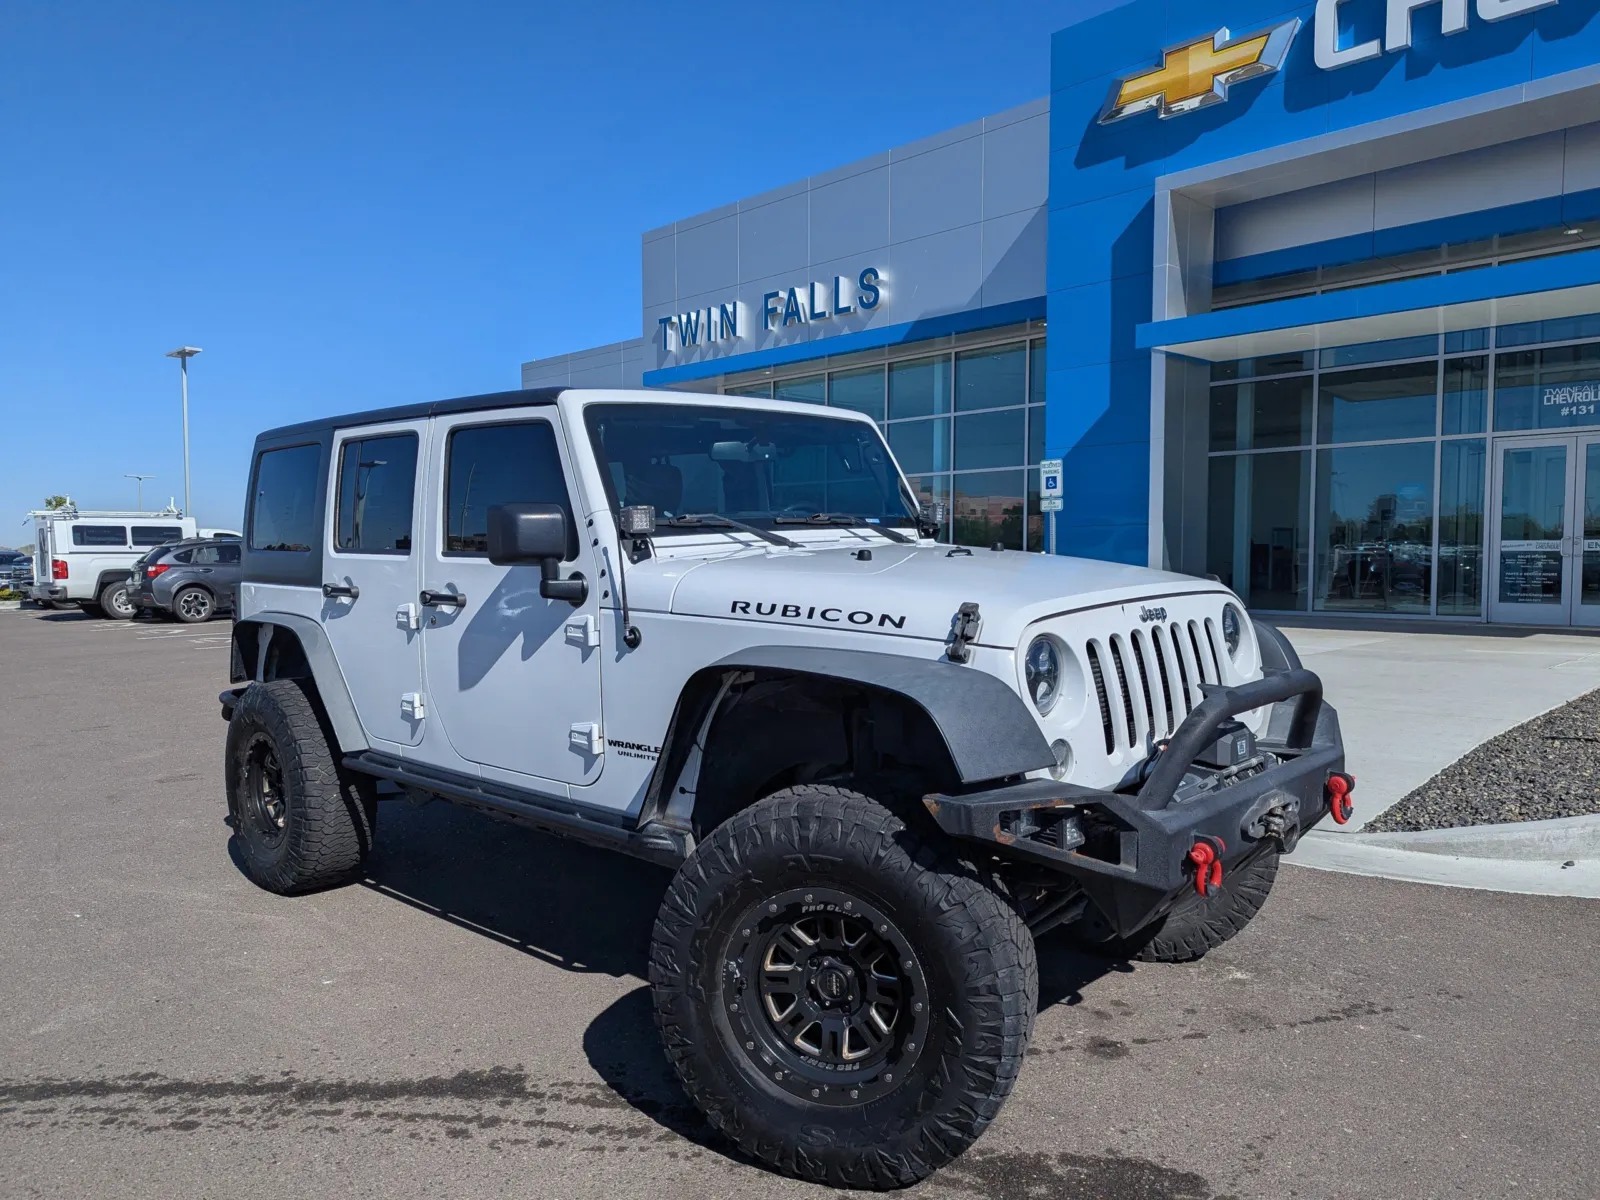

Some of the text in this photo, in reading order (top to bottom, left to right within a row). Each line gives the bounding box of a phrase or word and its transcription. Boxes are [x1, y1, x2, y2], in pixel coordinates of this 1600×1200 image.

[658, 267, 884, 351] TWIN FALLS
[1560, 404, 1595, 417] #131
[730, 600, 906, 629] RUBICON
[1139, 605, 1167, 623] Jeep
[607, 738, 661, 754] WRANGLE
